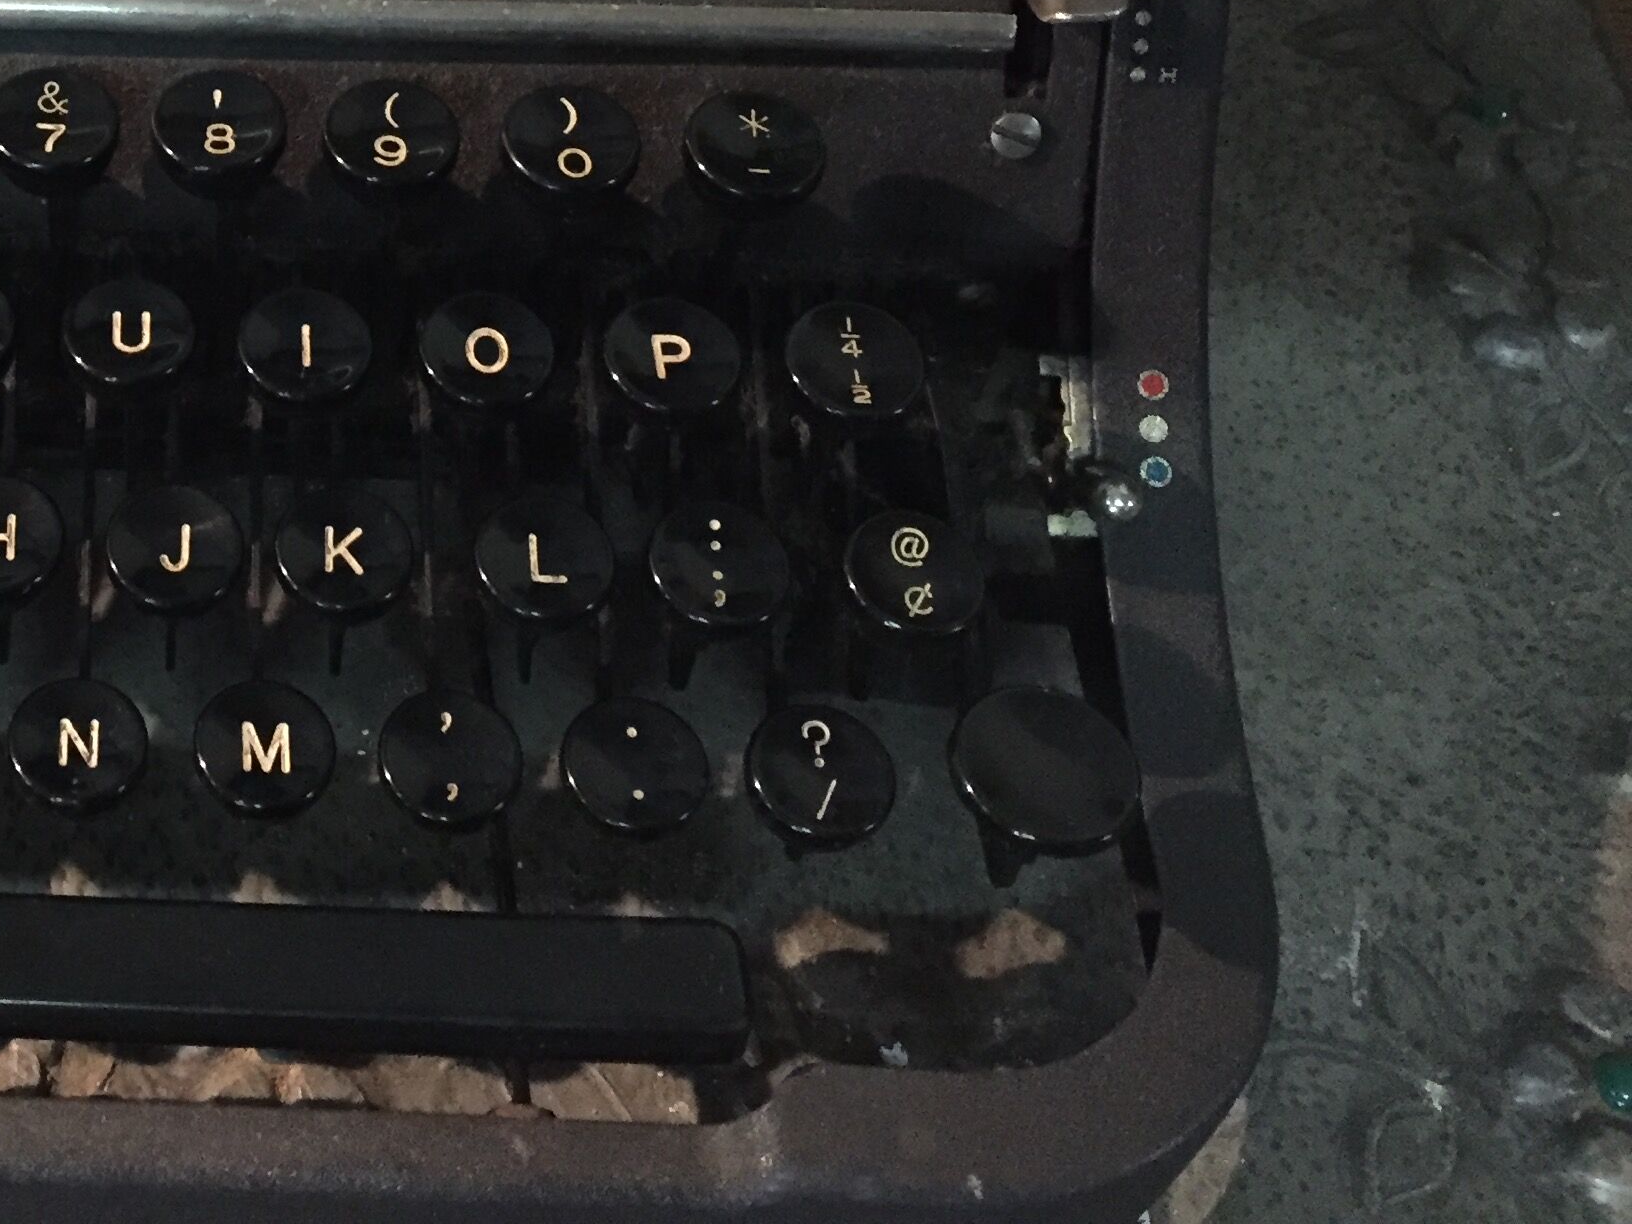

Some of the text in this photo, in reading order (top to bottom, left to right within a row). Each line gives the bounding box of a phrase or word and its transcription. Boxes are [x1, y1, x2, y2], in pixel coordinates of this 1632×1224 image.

[37, 80, 69, 115] &
[35, 122, 67, 153] 7
[203, 123, 236, 154] 8
[373, 134, 407, 167] 9
[557, 147, 593, 178] 0
[112, 310, 151, 353] U
[301, 323, 311, 367] I
[465, 326, 509, 374] O
[650, 334, 691, 379] P
[159, 523, 191, 572] J
[324, 525, 364, 576] K
[528, 532, 568, 584] L
[890, 526, 929, 567] @
[58, 717, 100, 768] N
[241, 721, 291, 774] M
[801, 719, 831, 768] ?
